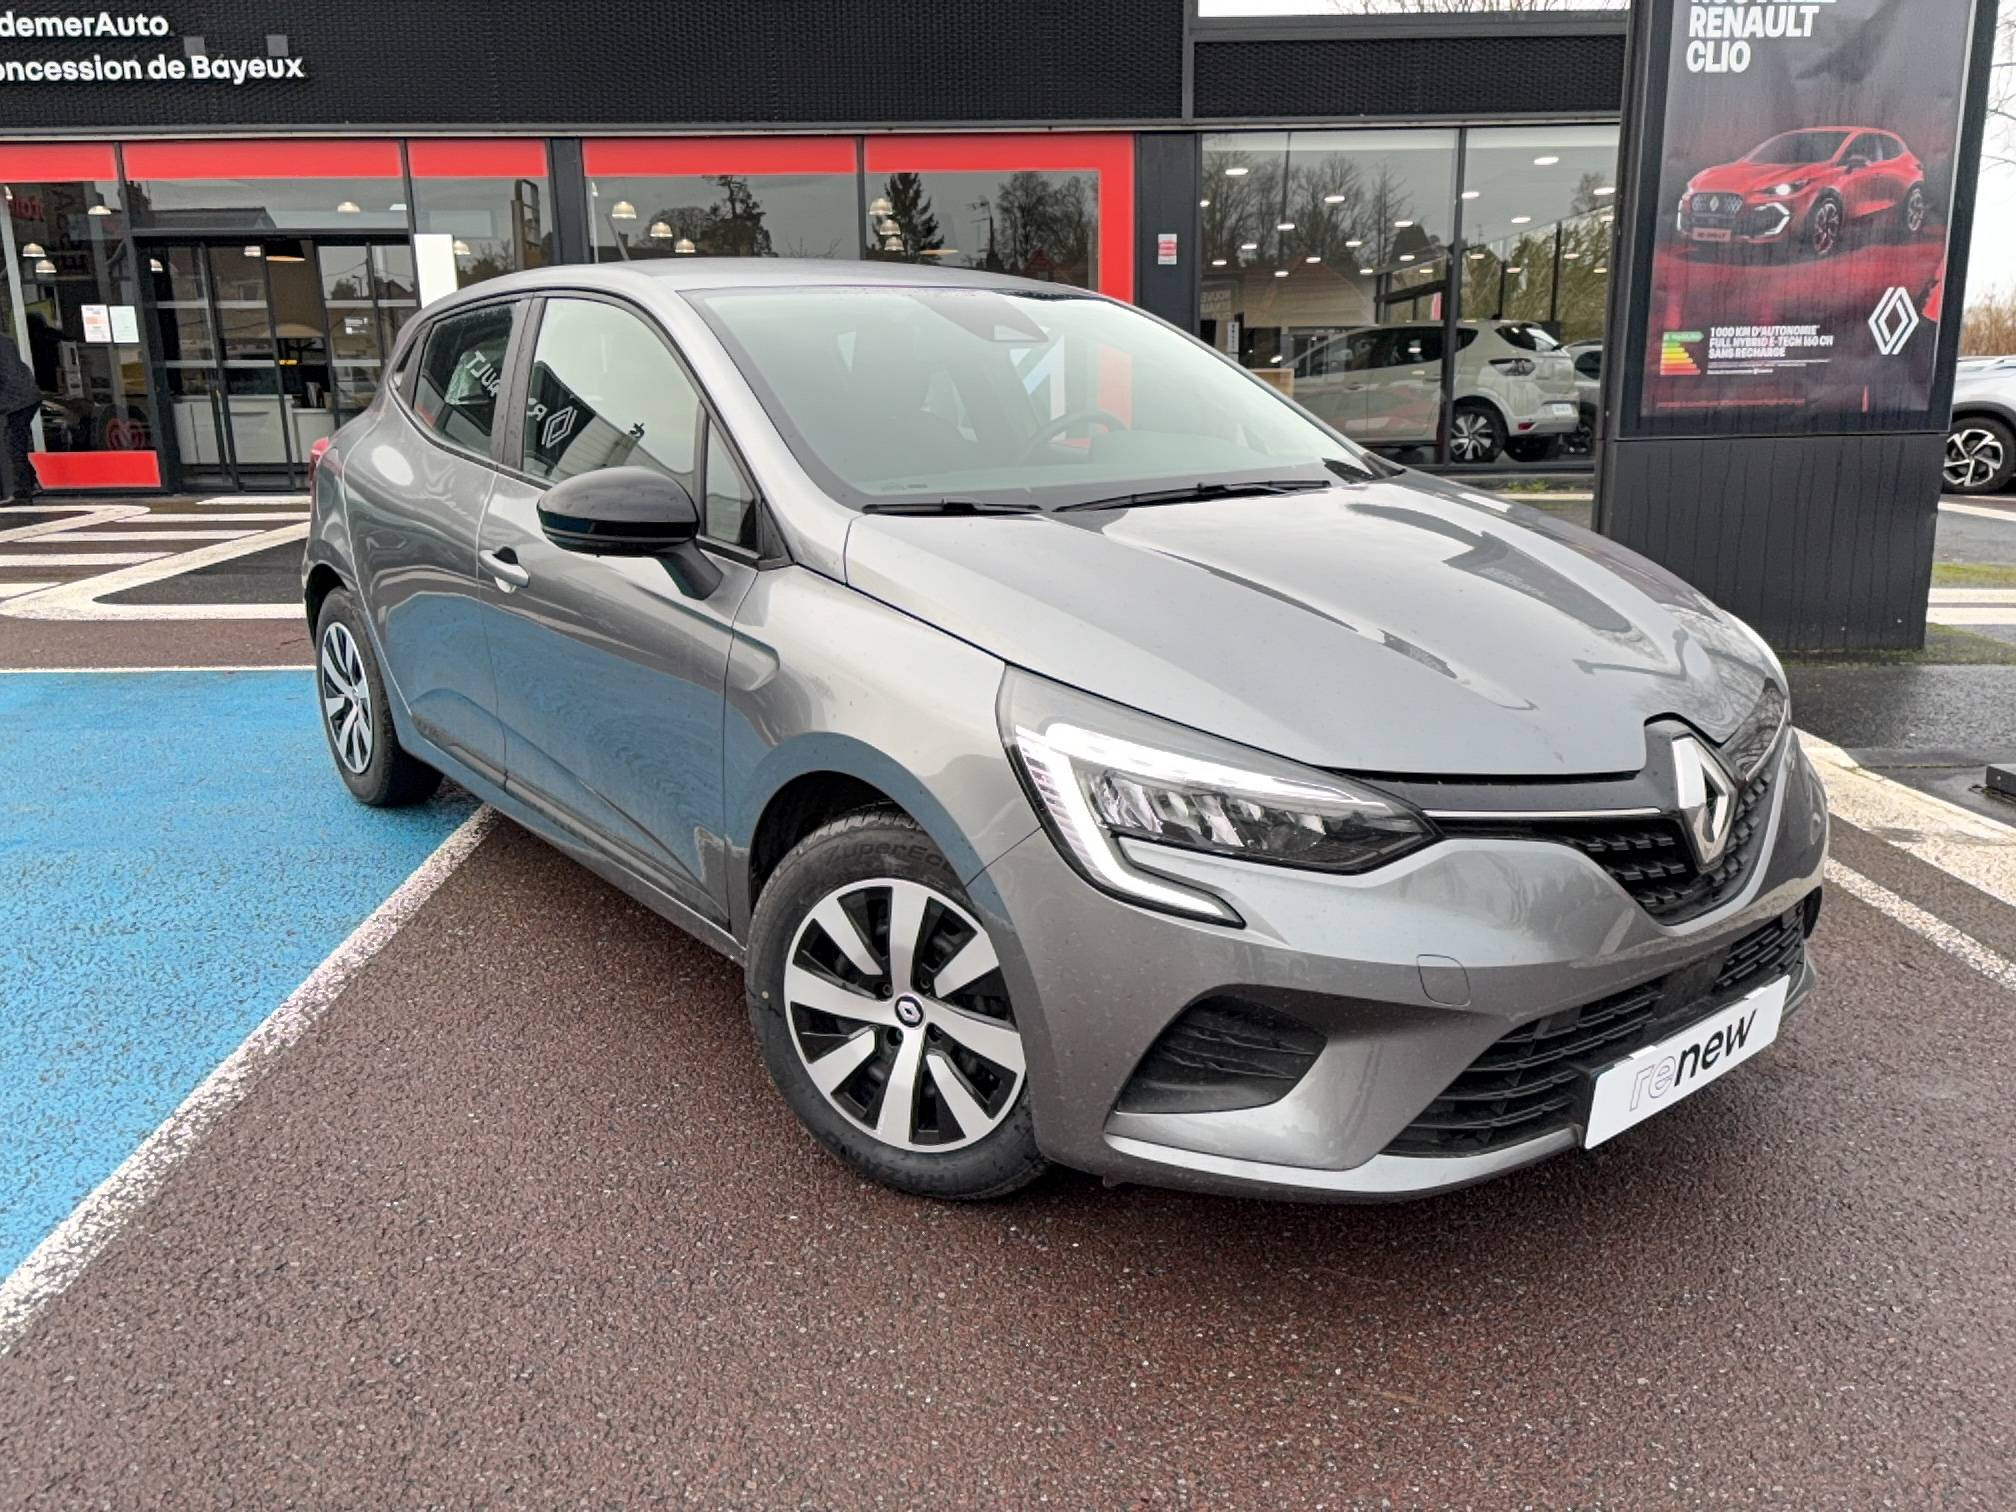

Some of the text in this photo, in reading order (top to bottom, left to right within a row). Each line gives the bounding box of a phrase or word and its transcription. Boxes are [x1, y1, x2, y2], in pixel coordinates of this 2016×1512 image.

[0, 11, 169, 37] demerAuto
[1689, 5, 1820, 38] RENAULT
[0, 54, 304, 85] ncession de Bayeux
[1686, 40, 1751, 73] CLIO
[1708, 347, 1786, 358] SANS RECHARGE
[1709, 338, 1732, 347] FULL
[1733, 337, 1768, 347] HYBRID
[1629, 1008, 1758, 1112] renew
